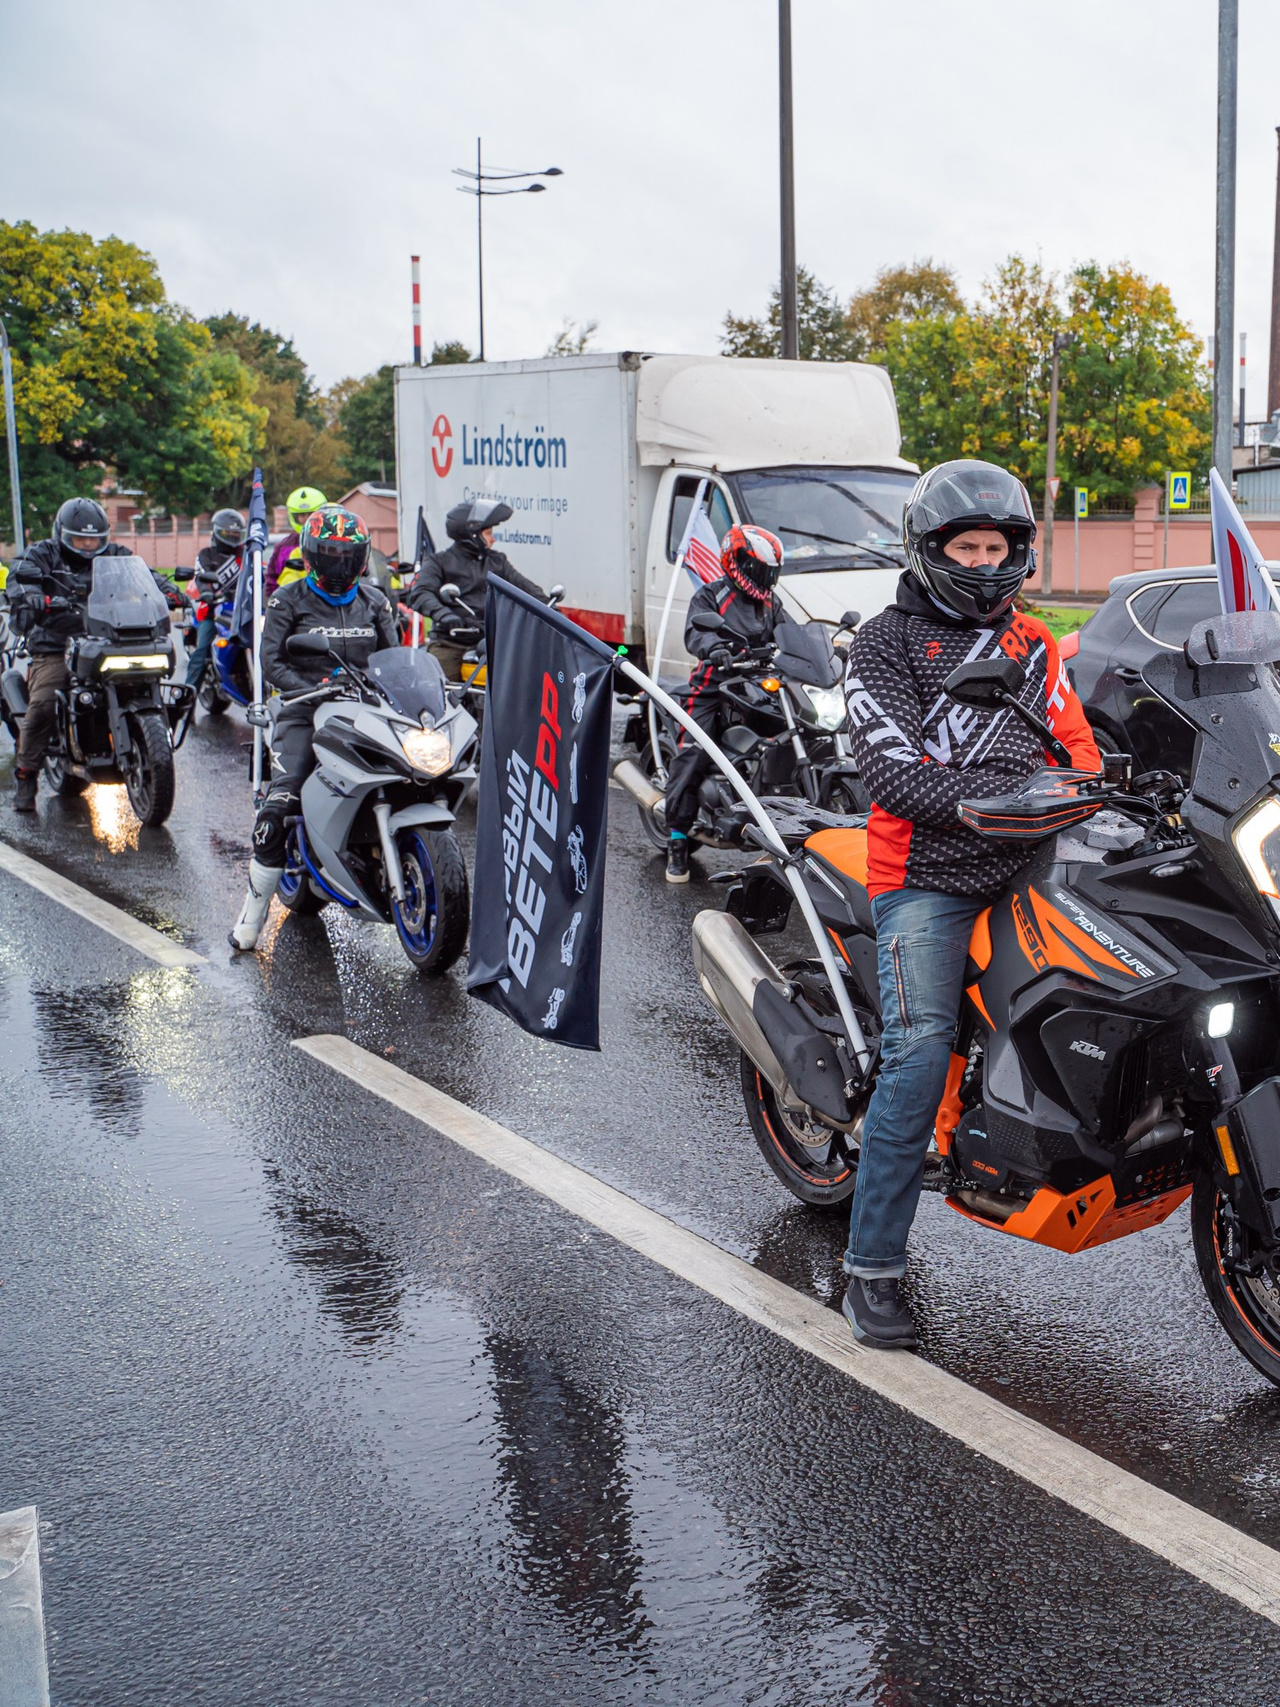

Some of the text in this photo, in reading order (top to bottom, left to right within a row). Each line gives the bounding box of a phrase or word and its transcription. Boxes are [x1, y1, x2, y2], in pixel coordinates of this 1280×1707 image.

[462, 424, 567, 468] Lindström
[537, 493, 568, 517] image
[1054, 891, 1086, 916] SUPER
[1074, 915, 1156, 979] ADVENTURE
[1069, 1041, 1107, 1061] KTM
[1226, 1225, 1234, 1258] brembo
